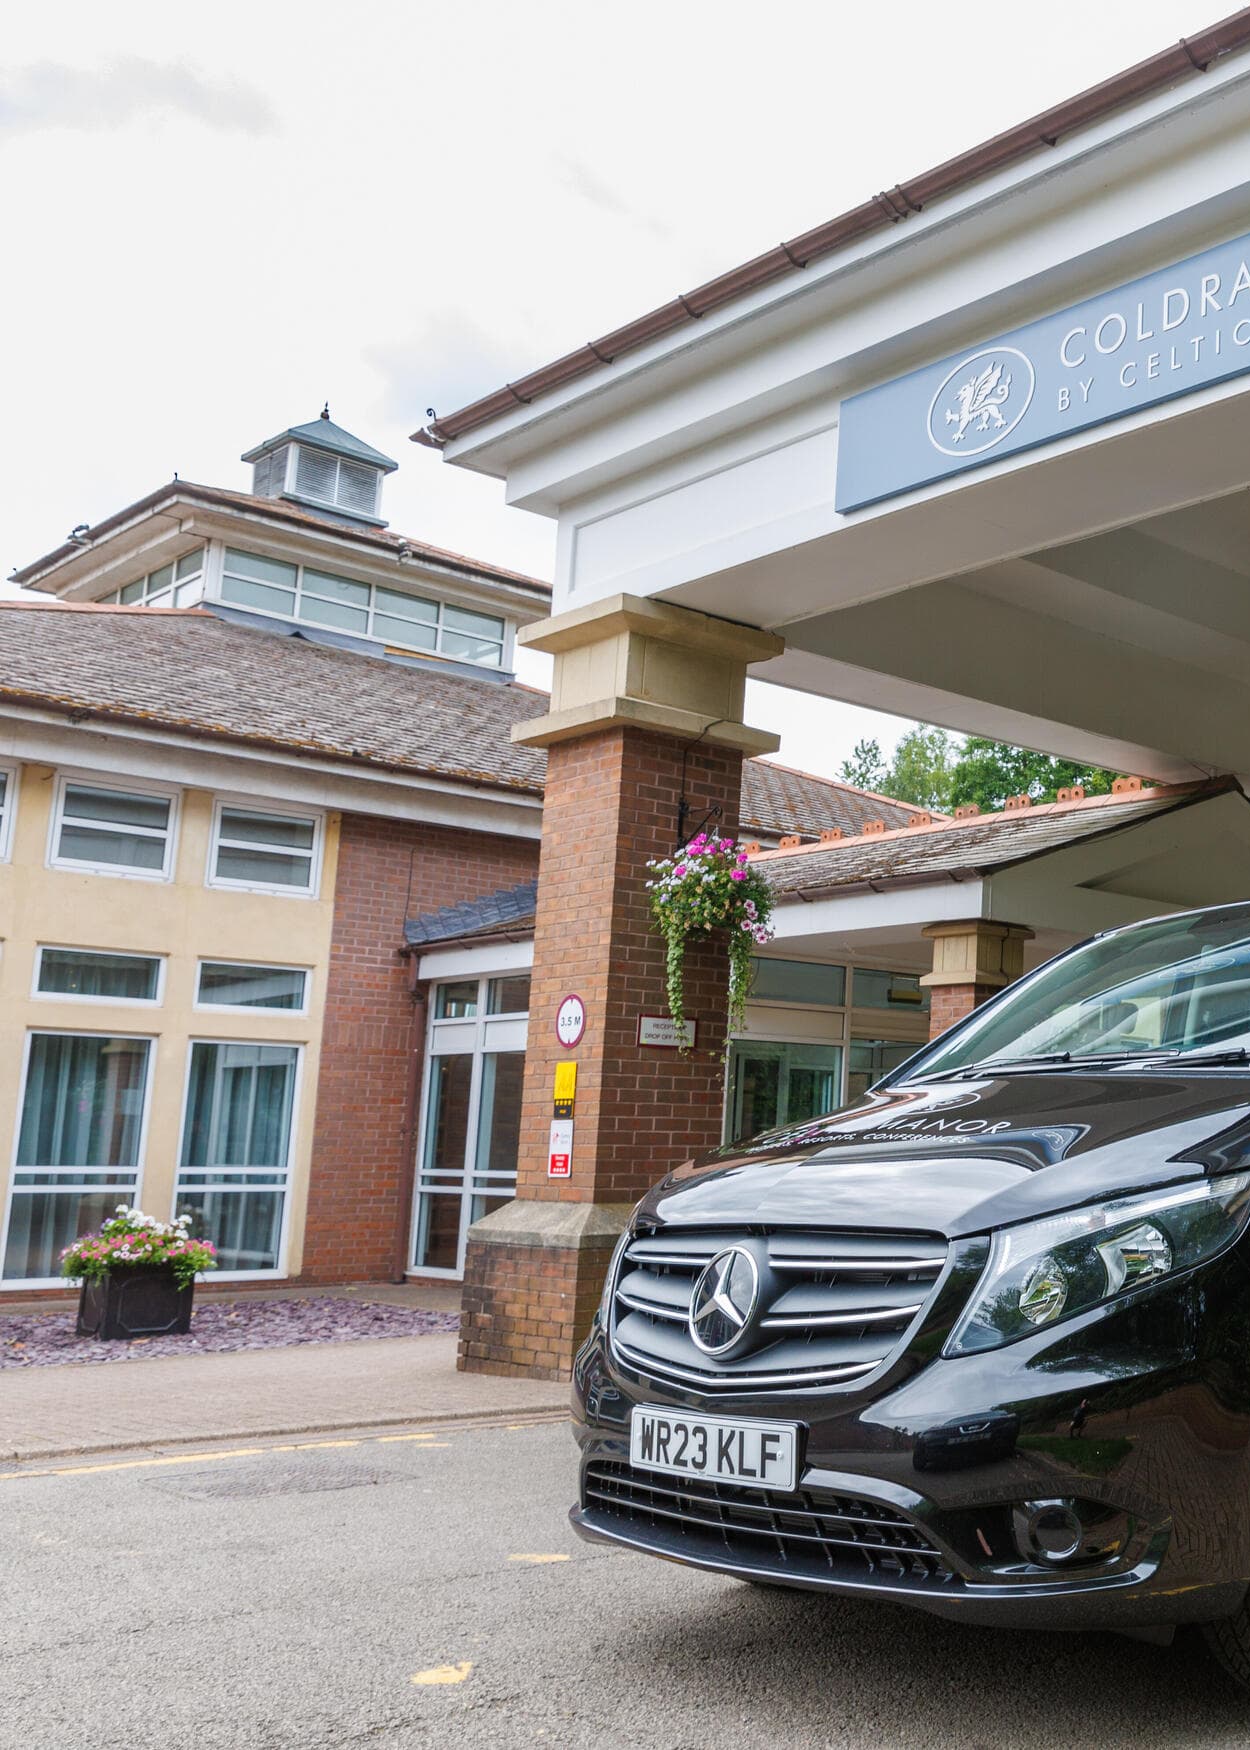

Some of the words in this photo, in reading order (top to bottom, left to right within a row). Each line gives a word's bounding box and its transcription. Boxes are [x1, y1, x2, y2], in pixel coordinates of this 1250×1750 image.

[1058, 377, 1094, 412] BY
[560, 1016, 573, 1027] 3.5
[574, 1015, 581, 1026] M
[641, 1417, 708, 1470] WR23
[717, 1428, 780, 1479] KLF
